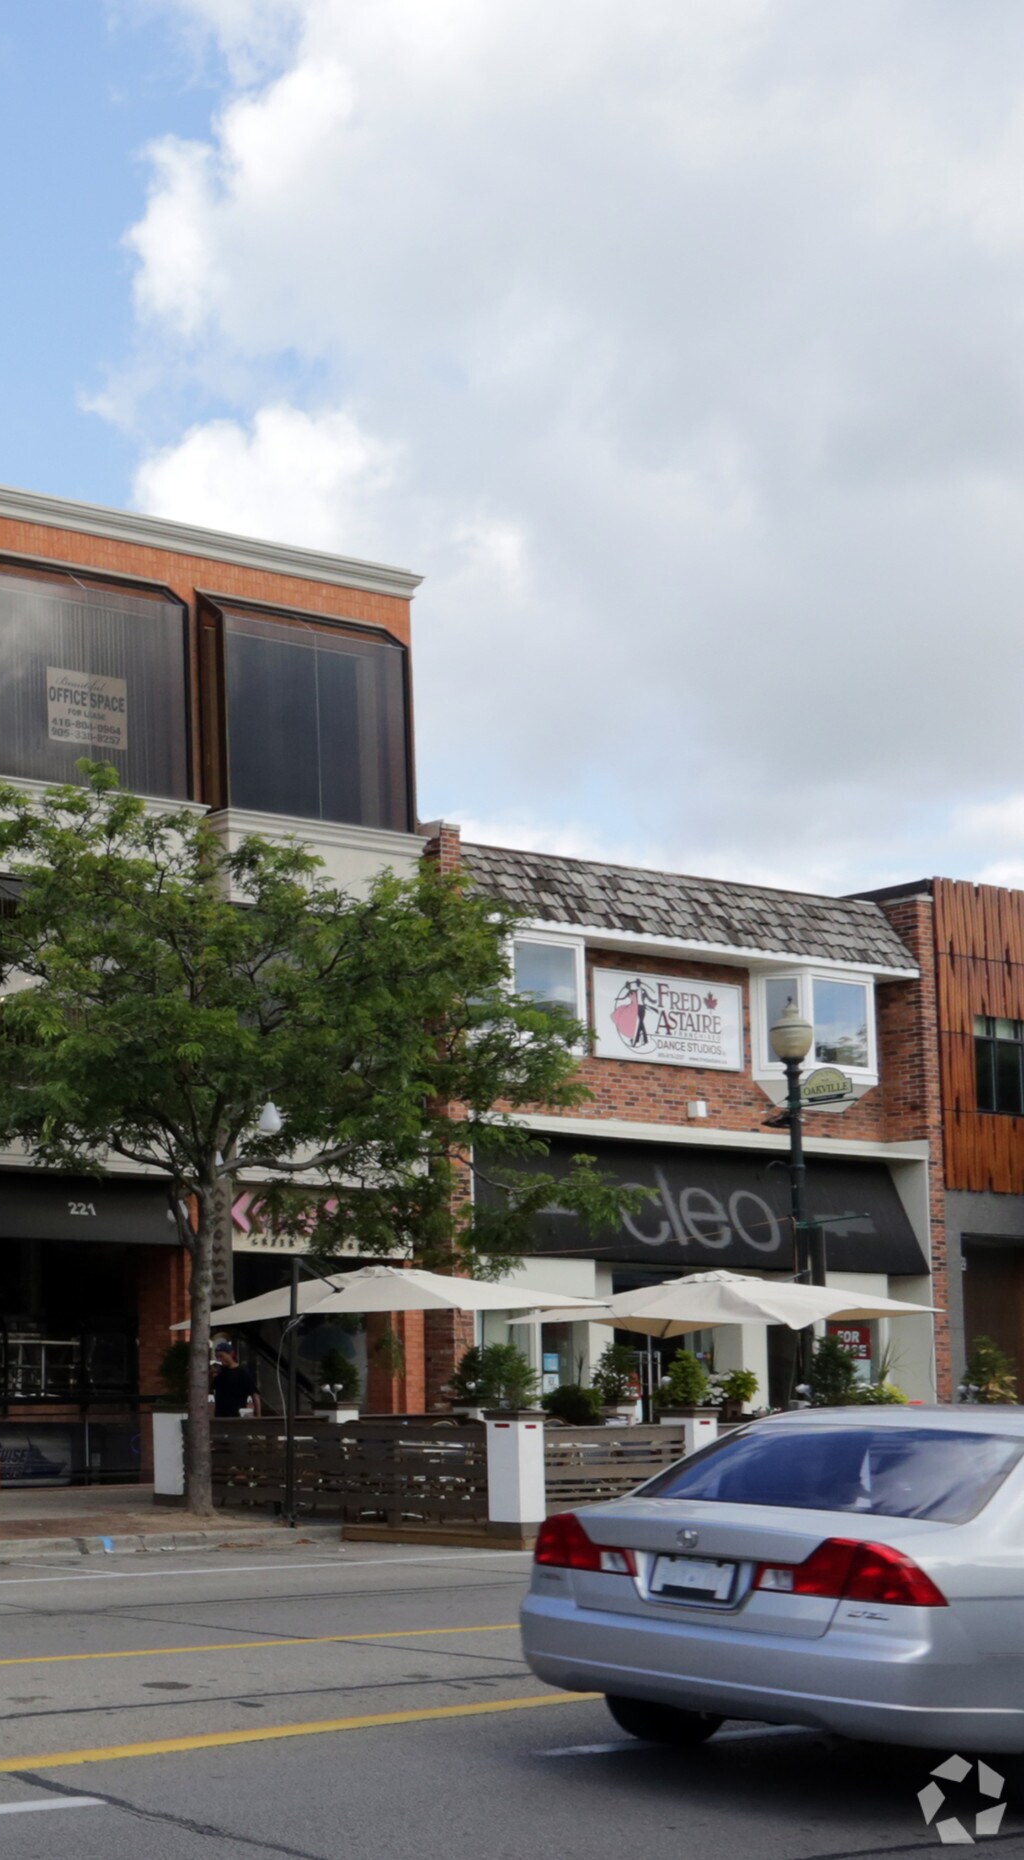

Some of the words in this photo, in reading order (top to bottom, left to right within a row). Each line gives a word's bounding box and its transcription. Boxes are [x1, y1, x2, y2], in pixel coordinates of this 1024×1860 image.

[48, 686, 88, 707] OFFICE
[89, 692, 125, 713] SPACE
[67, 708, 82, 717] FOR
[656, 983, 702, 1012] FRED
[655, 1010, 722, 1035] ASTAIRE
[657, 1039, 686, 1053] DANCE
[687, 1043, 722, 1056] STUDIOS
[803, 1081, 849, 1096] OAKVILLE
[68, 1201, 97, 1216] 221
[618, 1163, 781, 1252] cleo
[837, 1330, 860, 1343] FOR
